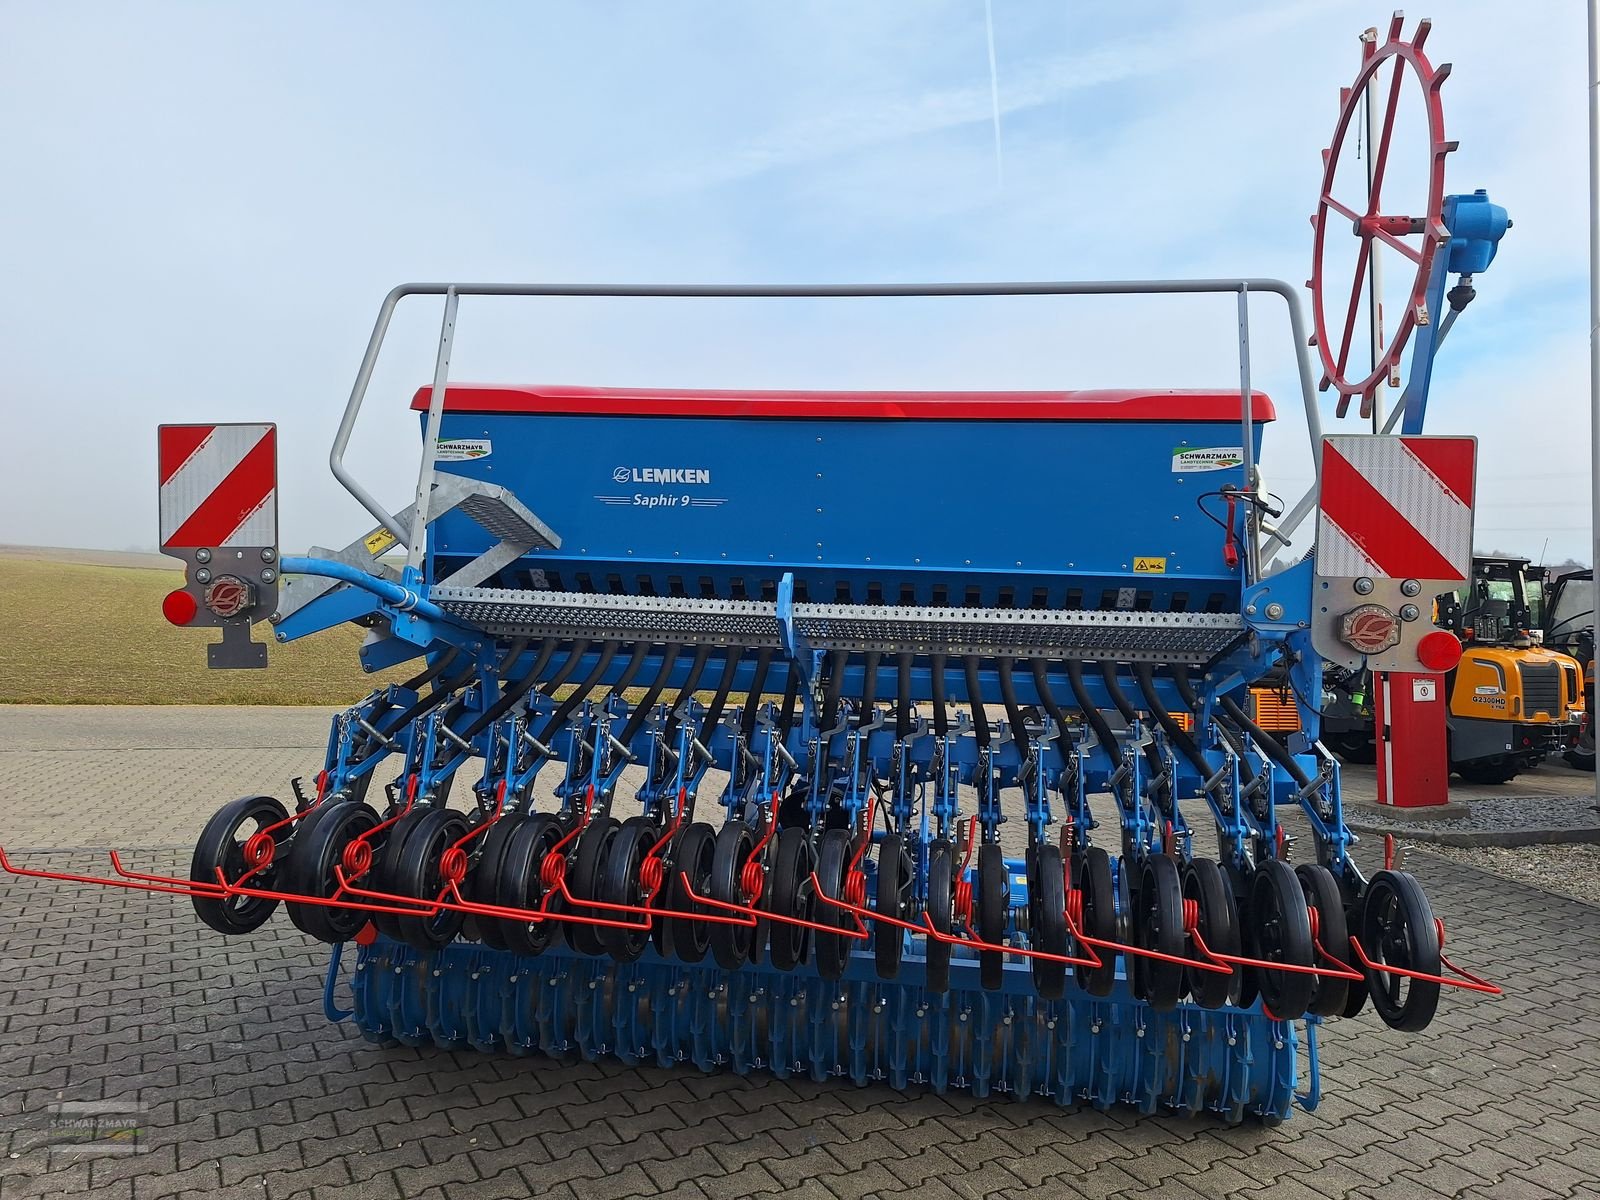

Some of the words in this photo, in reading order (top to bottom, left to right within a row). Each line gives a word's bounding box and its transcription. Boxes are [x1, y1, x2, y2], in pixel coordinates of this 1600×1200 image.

[632, 468, 710, 486] LEMKEN
[633, 494, 678, 508] Saphir
[681, 495, 690, 506] 9
[1472, 696, 1506, 705] G2300HD
